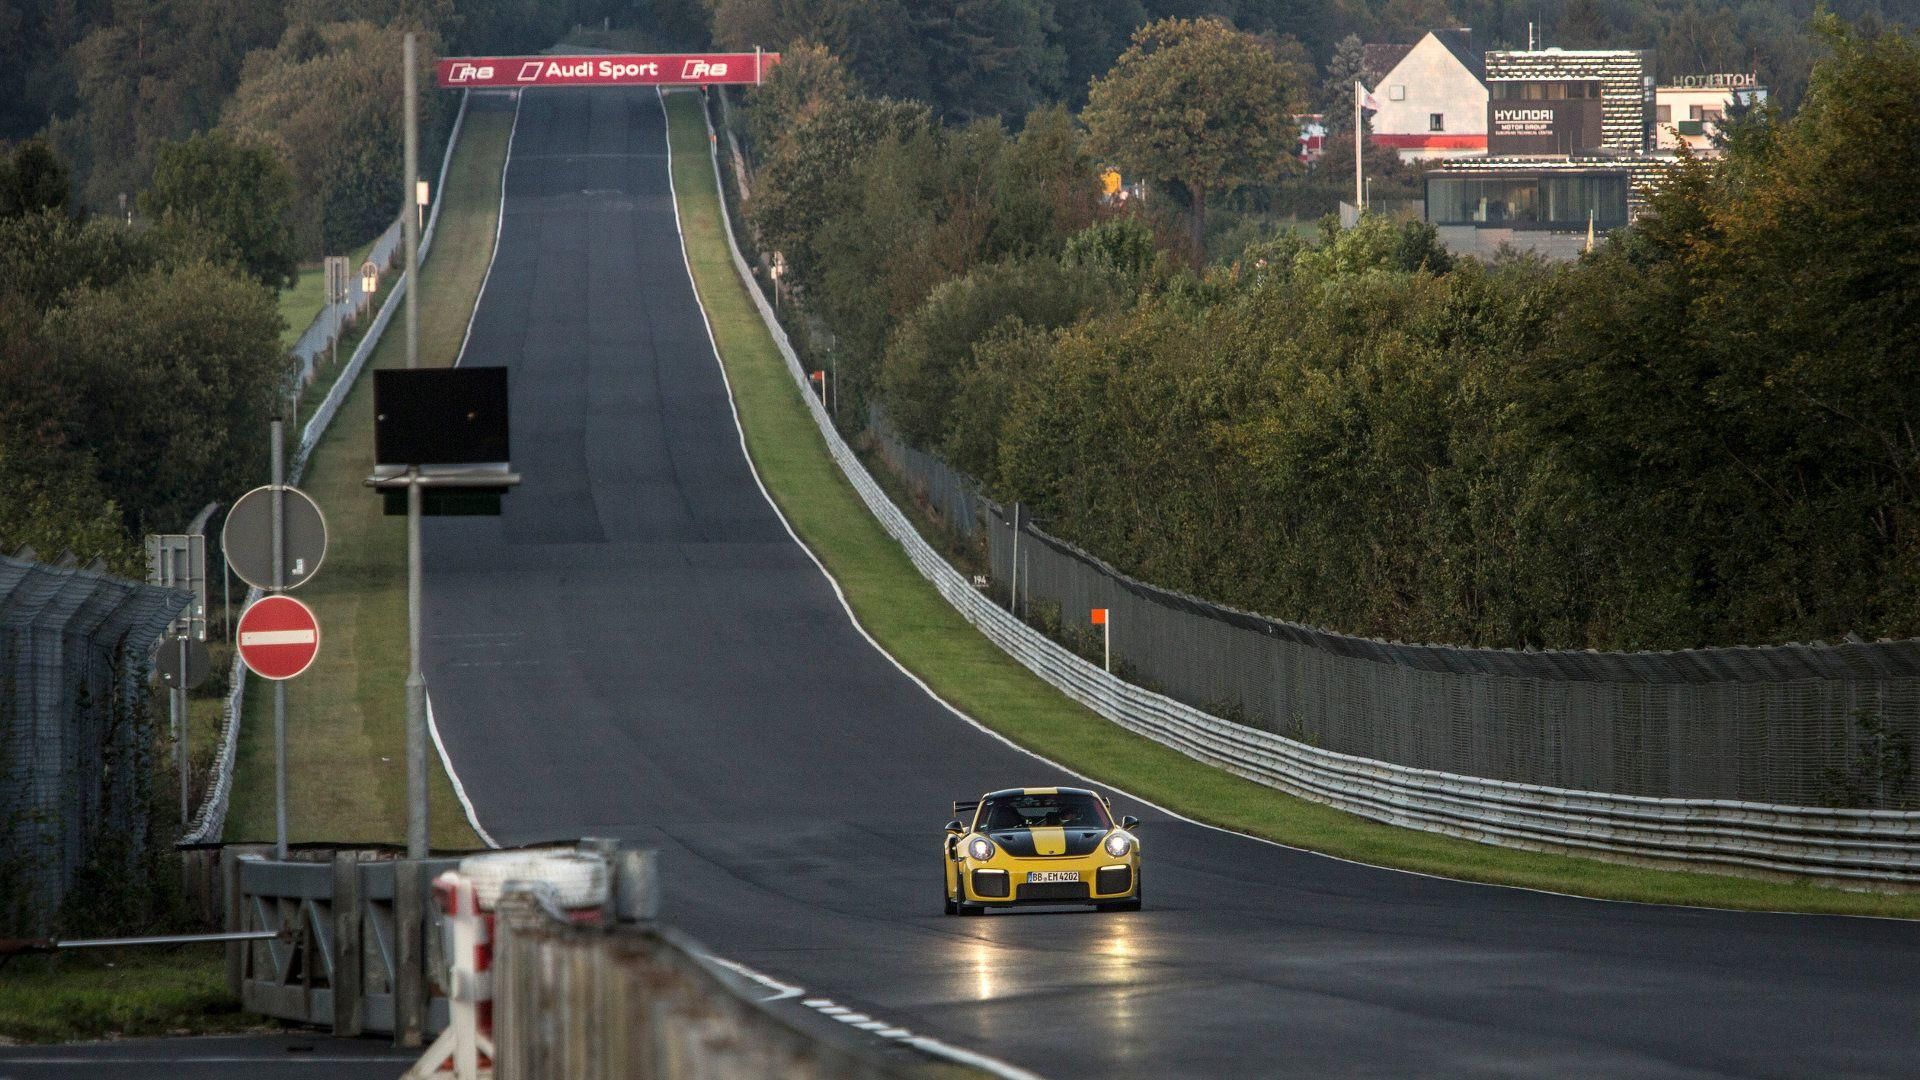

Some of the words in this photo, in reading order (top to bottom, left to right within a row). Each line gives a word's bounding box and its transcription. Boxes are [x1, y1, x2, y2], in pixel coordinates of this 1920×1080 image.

[457, 65, 495, 80] R8
[545, 61, 594, 78] Audi
[598, 60, 659, 80] Sport
[691, 62, 729, 77] R8
[1494, 109, 1554, 121] HYUNDAI
[1032, 873, 1043, 882] BB
[1047, 872, 1058, 881] EM
[1059, 872, 1078, 881] 4202
